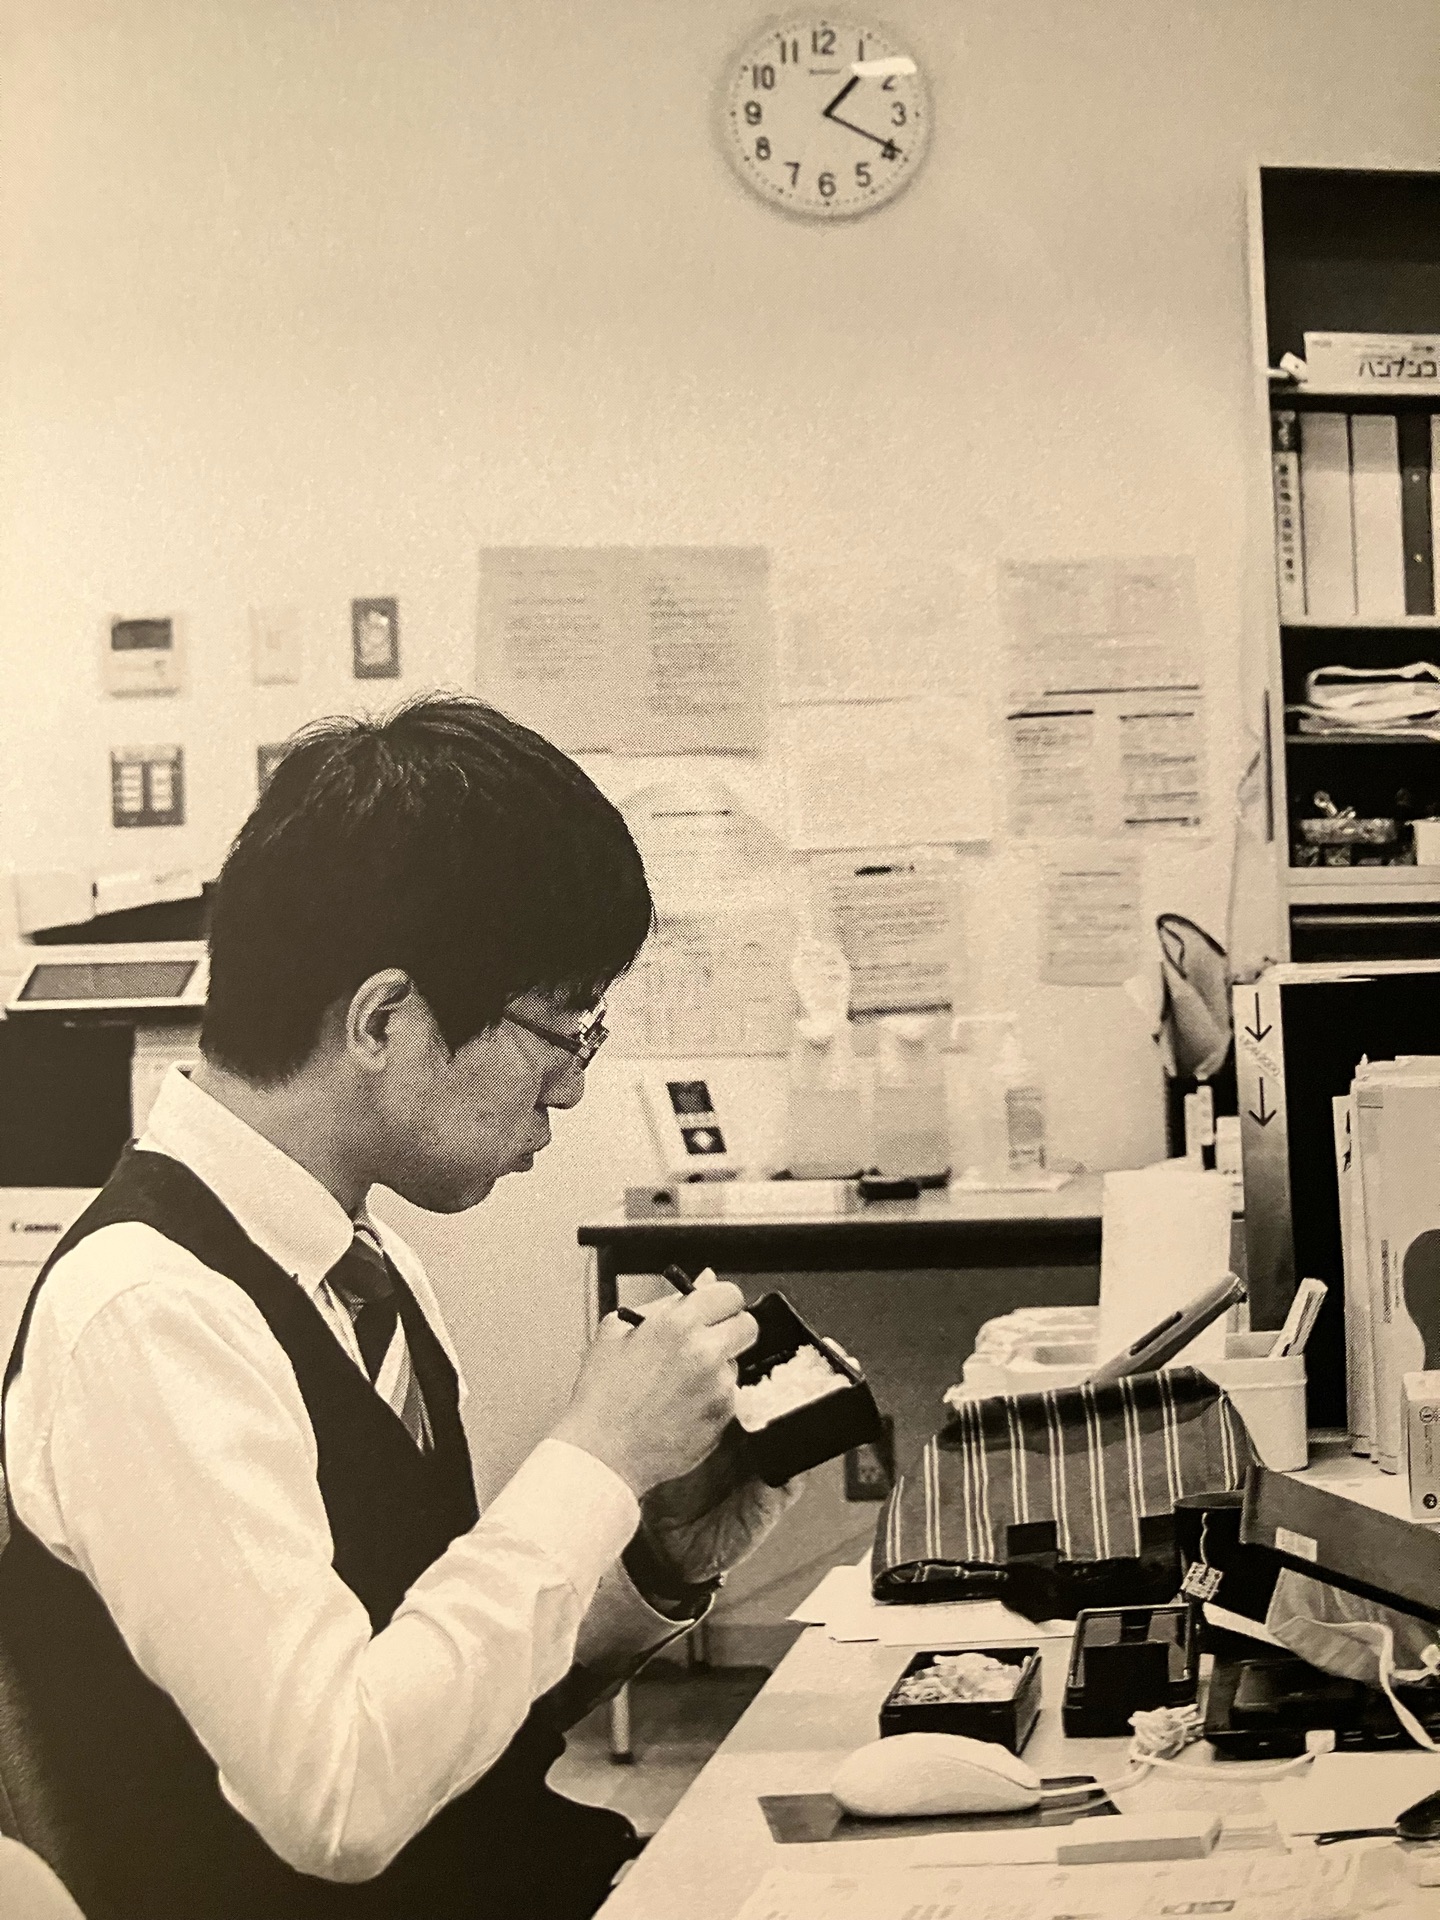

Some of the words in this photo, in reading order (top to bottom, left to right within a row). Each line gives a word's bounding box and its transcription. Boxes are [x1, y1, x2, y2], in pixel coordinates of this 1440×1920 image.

[780, 38, 799, 64] 11
[812, 29, 837, 55] 12
[857, 38, 864, 61] 1
[752, 64, 776, 90] 10
[881, 75, 897, 91] 2
[744, 100, 763, 126] 9
[890, 101, 907, 127] 3
[755, 136, 772, 161] 8
[783, 161, 801, 188] 7
[818, 171, 837, 198] 6
[855, 162, 872, 188] 5
